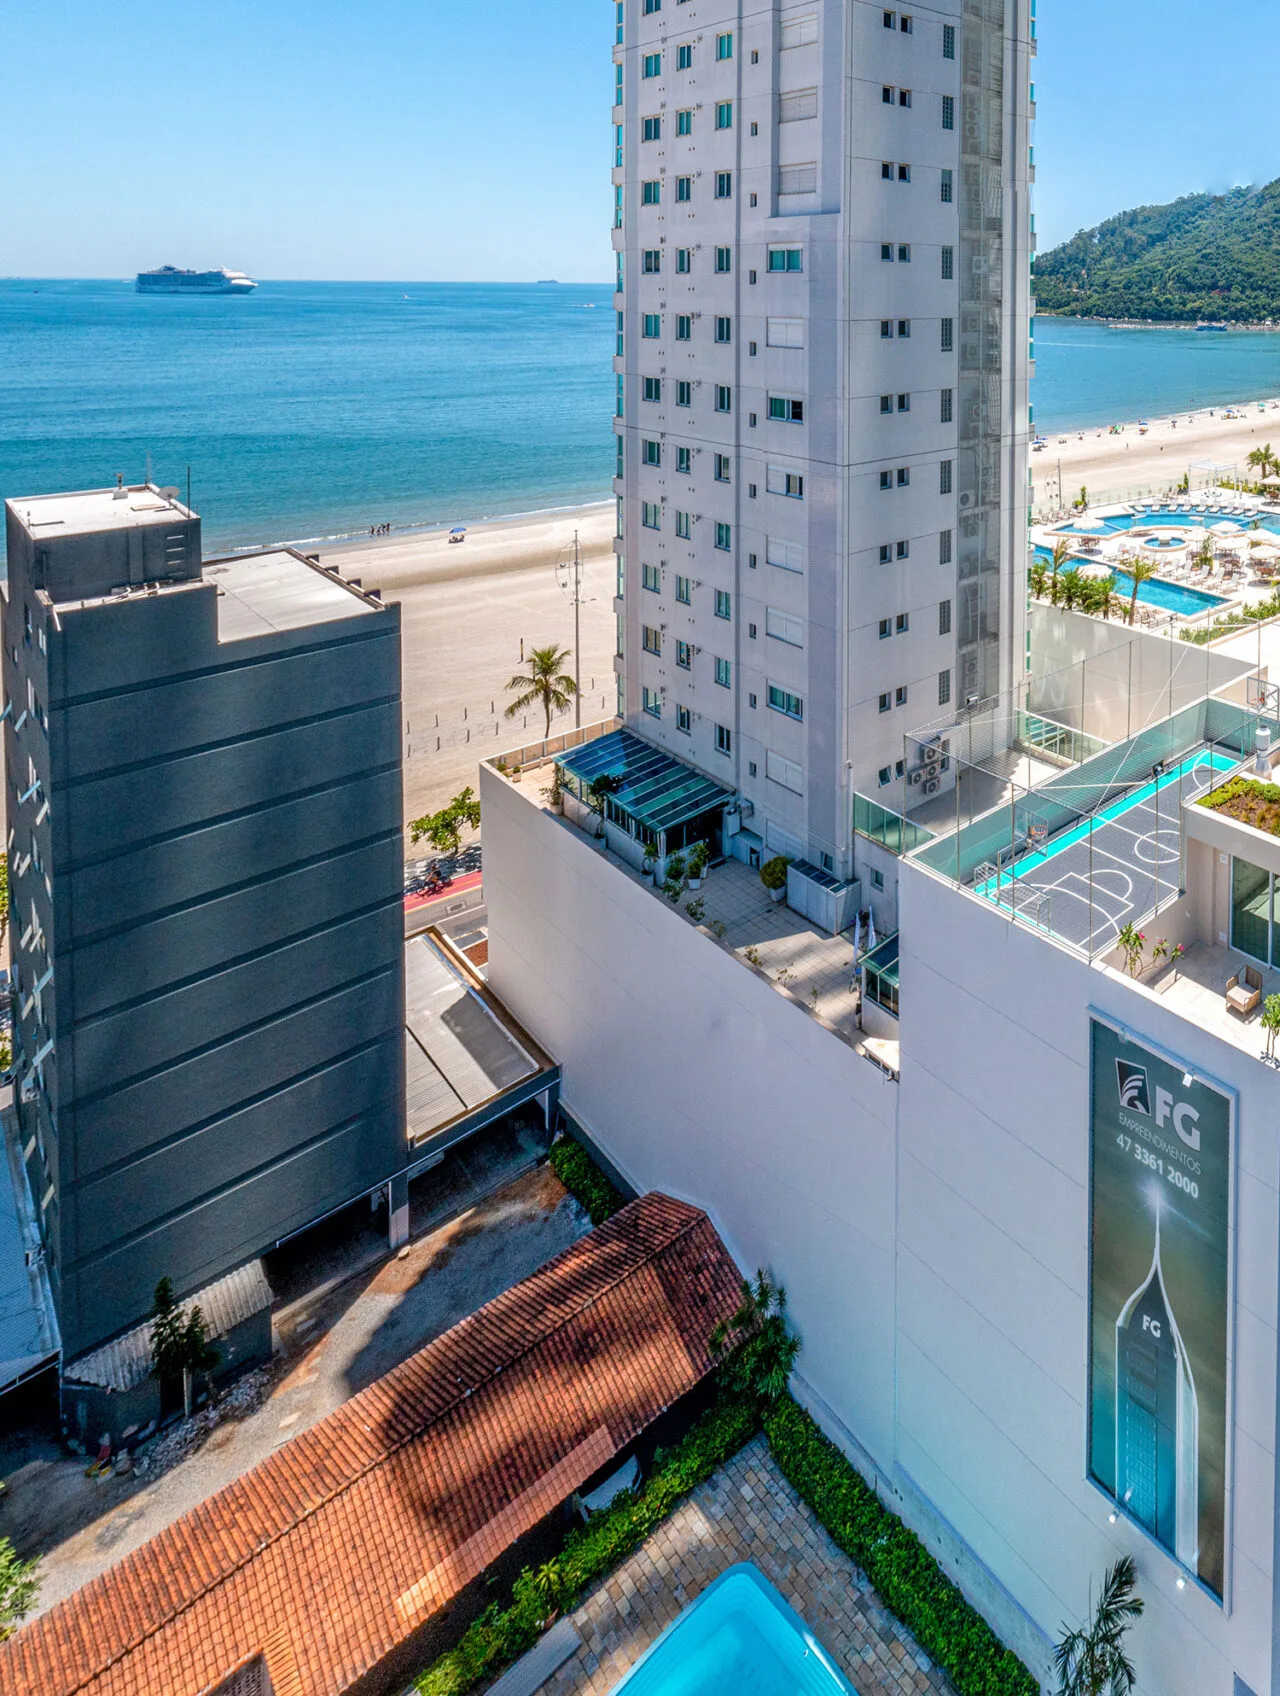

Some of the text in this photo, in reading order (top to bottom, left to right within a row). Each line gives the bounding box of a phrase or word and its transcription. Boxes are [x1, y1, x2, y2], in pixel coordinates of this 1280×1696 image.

[1119, 1112, 1201, 1175] EMPREENDIMENTOS
[1155, 1085, 1201, 1152] FG
[1116, 1133, 1199, 1199] 47 3361 2000
[1142, 1314, 1162, 1339] FG
